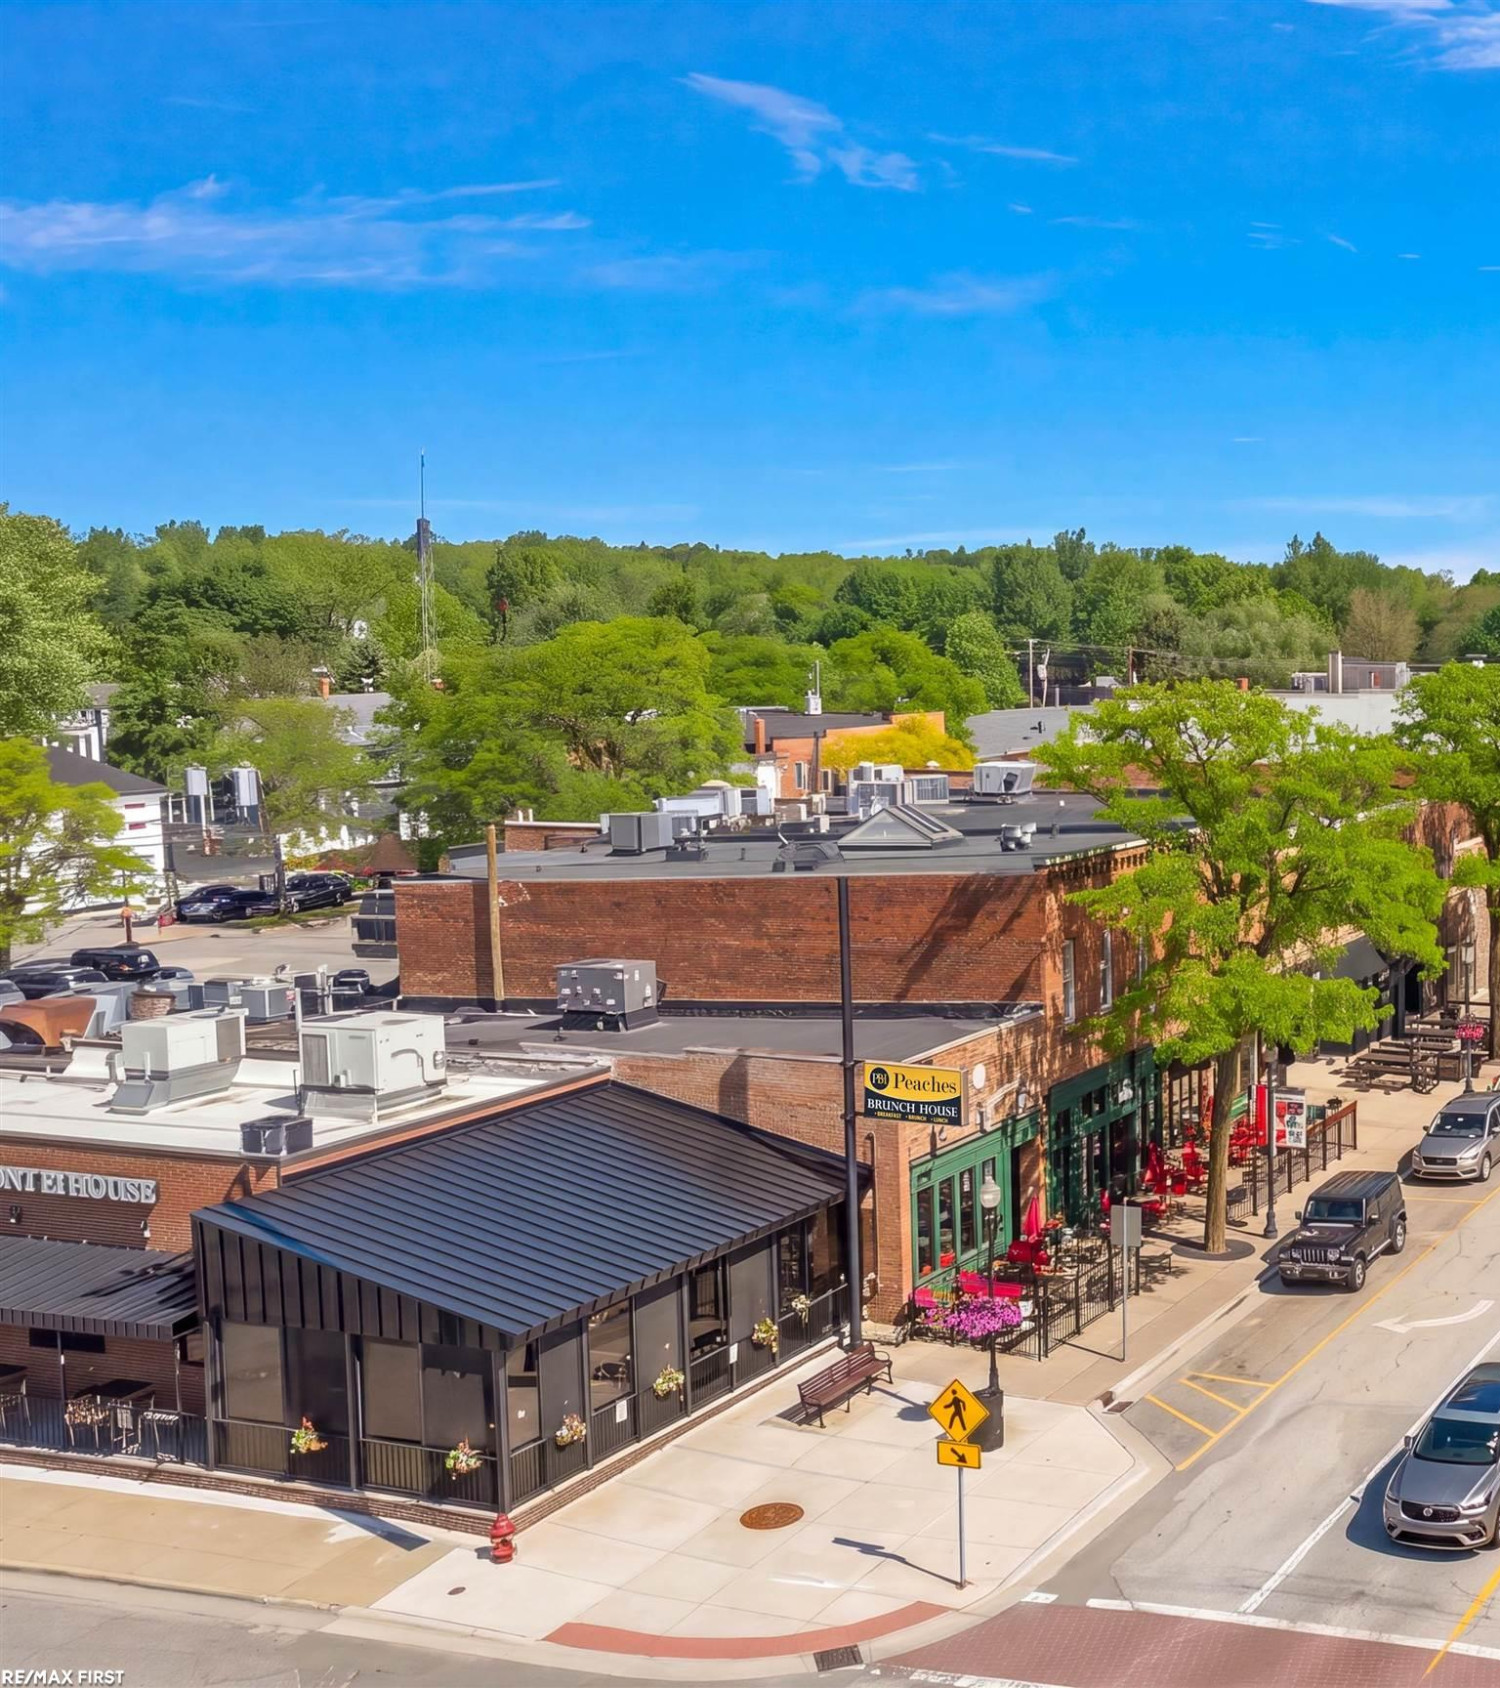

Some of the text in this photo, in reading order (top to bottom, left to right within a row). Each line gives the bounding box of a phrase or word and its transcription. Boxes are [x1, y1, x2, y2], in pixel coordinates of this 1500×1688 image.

[894, 1072, 957, 1094] Peaches
[867, 1098, 958, 1118] BRUNCH HOUSE
